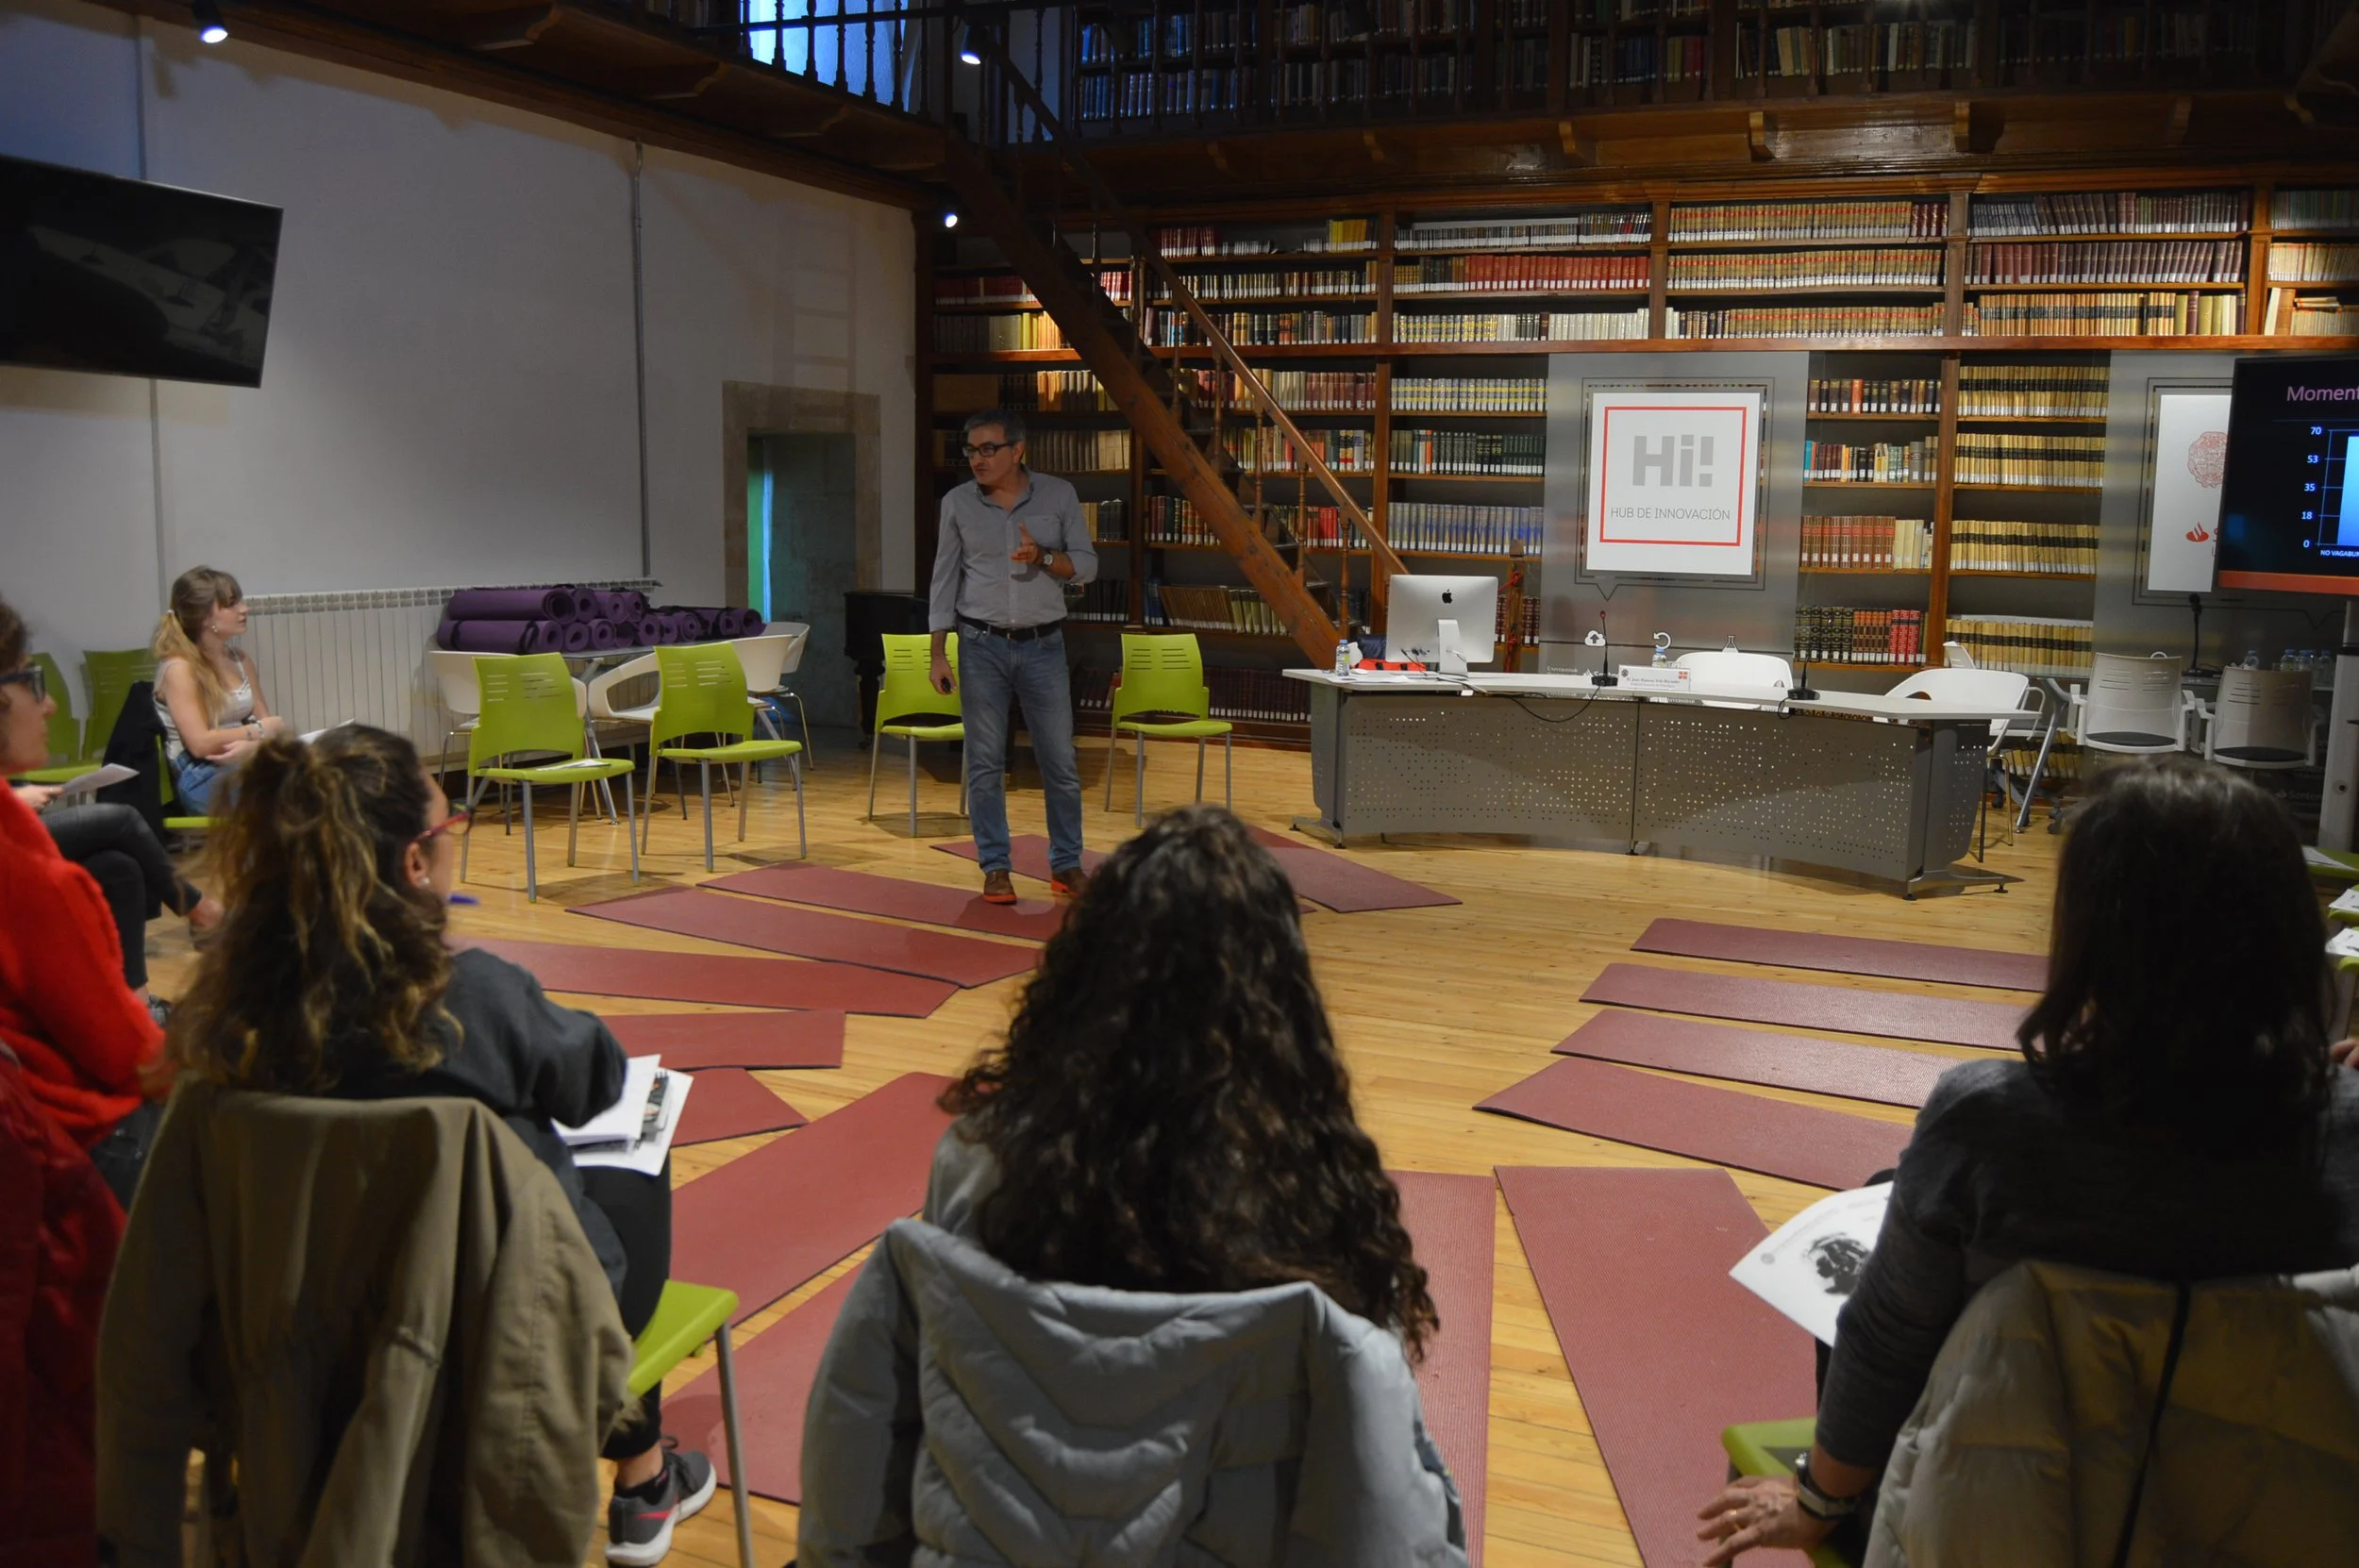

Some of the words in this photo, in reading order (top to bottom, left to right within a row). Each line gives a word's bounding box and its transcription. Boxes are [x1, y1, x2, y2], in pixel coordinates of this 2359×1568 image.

[2310, 426, 2322, 435] 70
[1632, 434, 1714, 487] Hi!
[2307, 455, 2318, 463] 53
[2303, 483, 2316, 492] 35
[1610, 507, 1634, 519] HUB
[1636, 507, 1652, 519] DE
[1654, 507, 1731, 521] INNOVACIÓN
[2301, 511, 2313, 520] 18
[2302, 540, 2310, 548] 0
